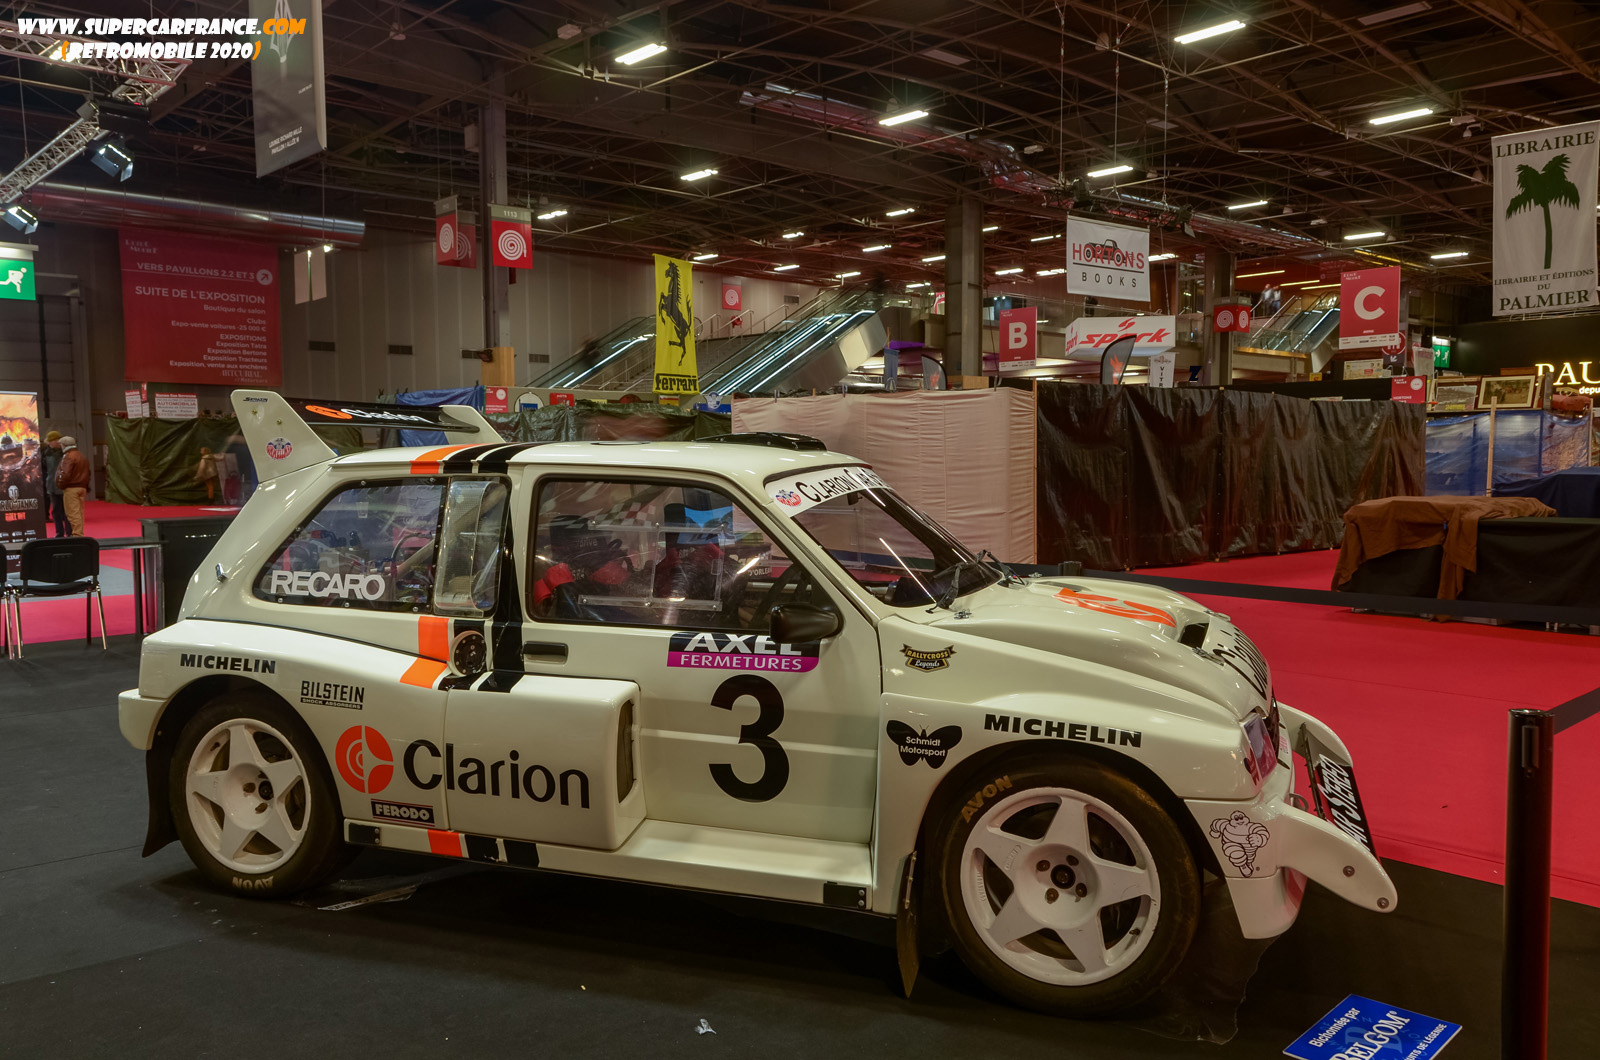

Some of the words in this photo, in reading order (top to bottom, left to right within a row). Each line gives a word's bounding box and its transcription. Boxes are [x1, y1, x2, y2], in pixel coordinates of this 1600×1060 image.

[1496, 131, 1596, 158] LIBRAIRIE
[503, 210, 518, 218] 1113
[1072, 242, 1145, 270] HORTONS
[136, 262, 164, 272] VERS
[165, 264, 219, 277] PAVILLONS
[221, 269, 234, 278] 2.2
[236, 271, 247, 279] ET
[1081, 271, 1137, 288] BOOKS
[1494, 275, 1538, 286] LIBRAIRIE
[1539, 273, 1550, 282] ET
[1552, 268, 1595, 280] ÉDITIONS
[135, 286, 169, 297] SUITE
[171, 288, 188, 299] DE
[190, 290, 266, 305] L'EXPOSITION
[1537, 283, 1551, 291] DU
[203, 304, 236, 313] Boutique
[1353, 285, 1386, 320] C
[1499, 289, 1590, 311] PALMIER
[171, 320, 209, 328] Expo-vente
[215, 340, 250, 349] Exposition
[219, 333, 267, 342] EXPOSITIONS
[1008, 321, 1028, 350] B
[202, 354, 238, 362] Exposition
[207, 347, 242, 356] Exposition
[795, 474, 859, 503] CLARION
[270, 569, 386, 601] RECARO
[683, 632, 802, 656] AXEL
[180, 653, 276, 674] MICHELIN
[680, 654, 802, 671] FERMETURES
[906, 650, 949, 659] RALLYCROSS
[915, 660, 940, 668] Legends
[301, 680, 365, 703] BILSTEIN
[302, 697, 324, 706] SHOCK
[325, 700, 362, 710] ABSORBERS
[709, 674, 790, 804] 3
[984, 713, 1142, 748] MICHELIN
[905, 736, 941, 747] Schmidt
[900, 745, 946, 757] Motorsport
[403, 739, 590, 809] Clarion
[1317, 753, 1362, 821] STEREO
[961, 775, 1013, 824] AVON
[374, 804, 431, 821] FERODO
[232, 875, 275, 890] AVON
[1308, 1016, 1351, 1048] Bichonnée
[1345, 1007, 1361, 1021] par
[1416, 1042, 1429, 1052] DE
[1424, 1023, 1448, 1046] LÉGENDE
